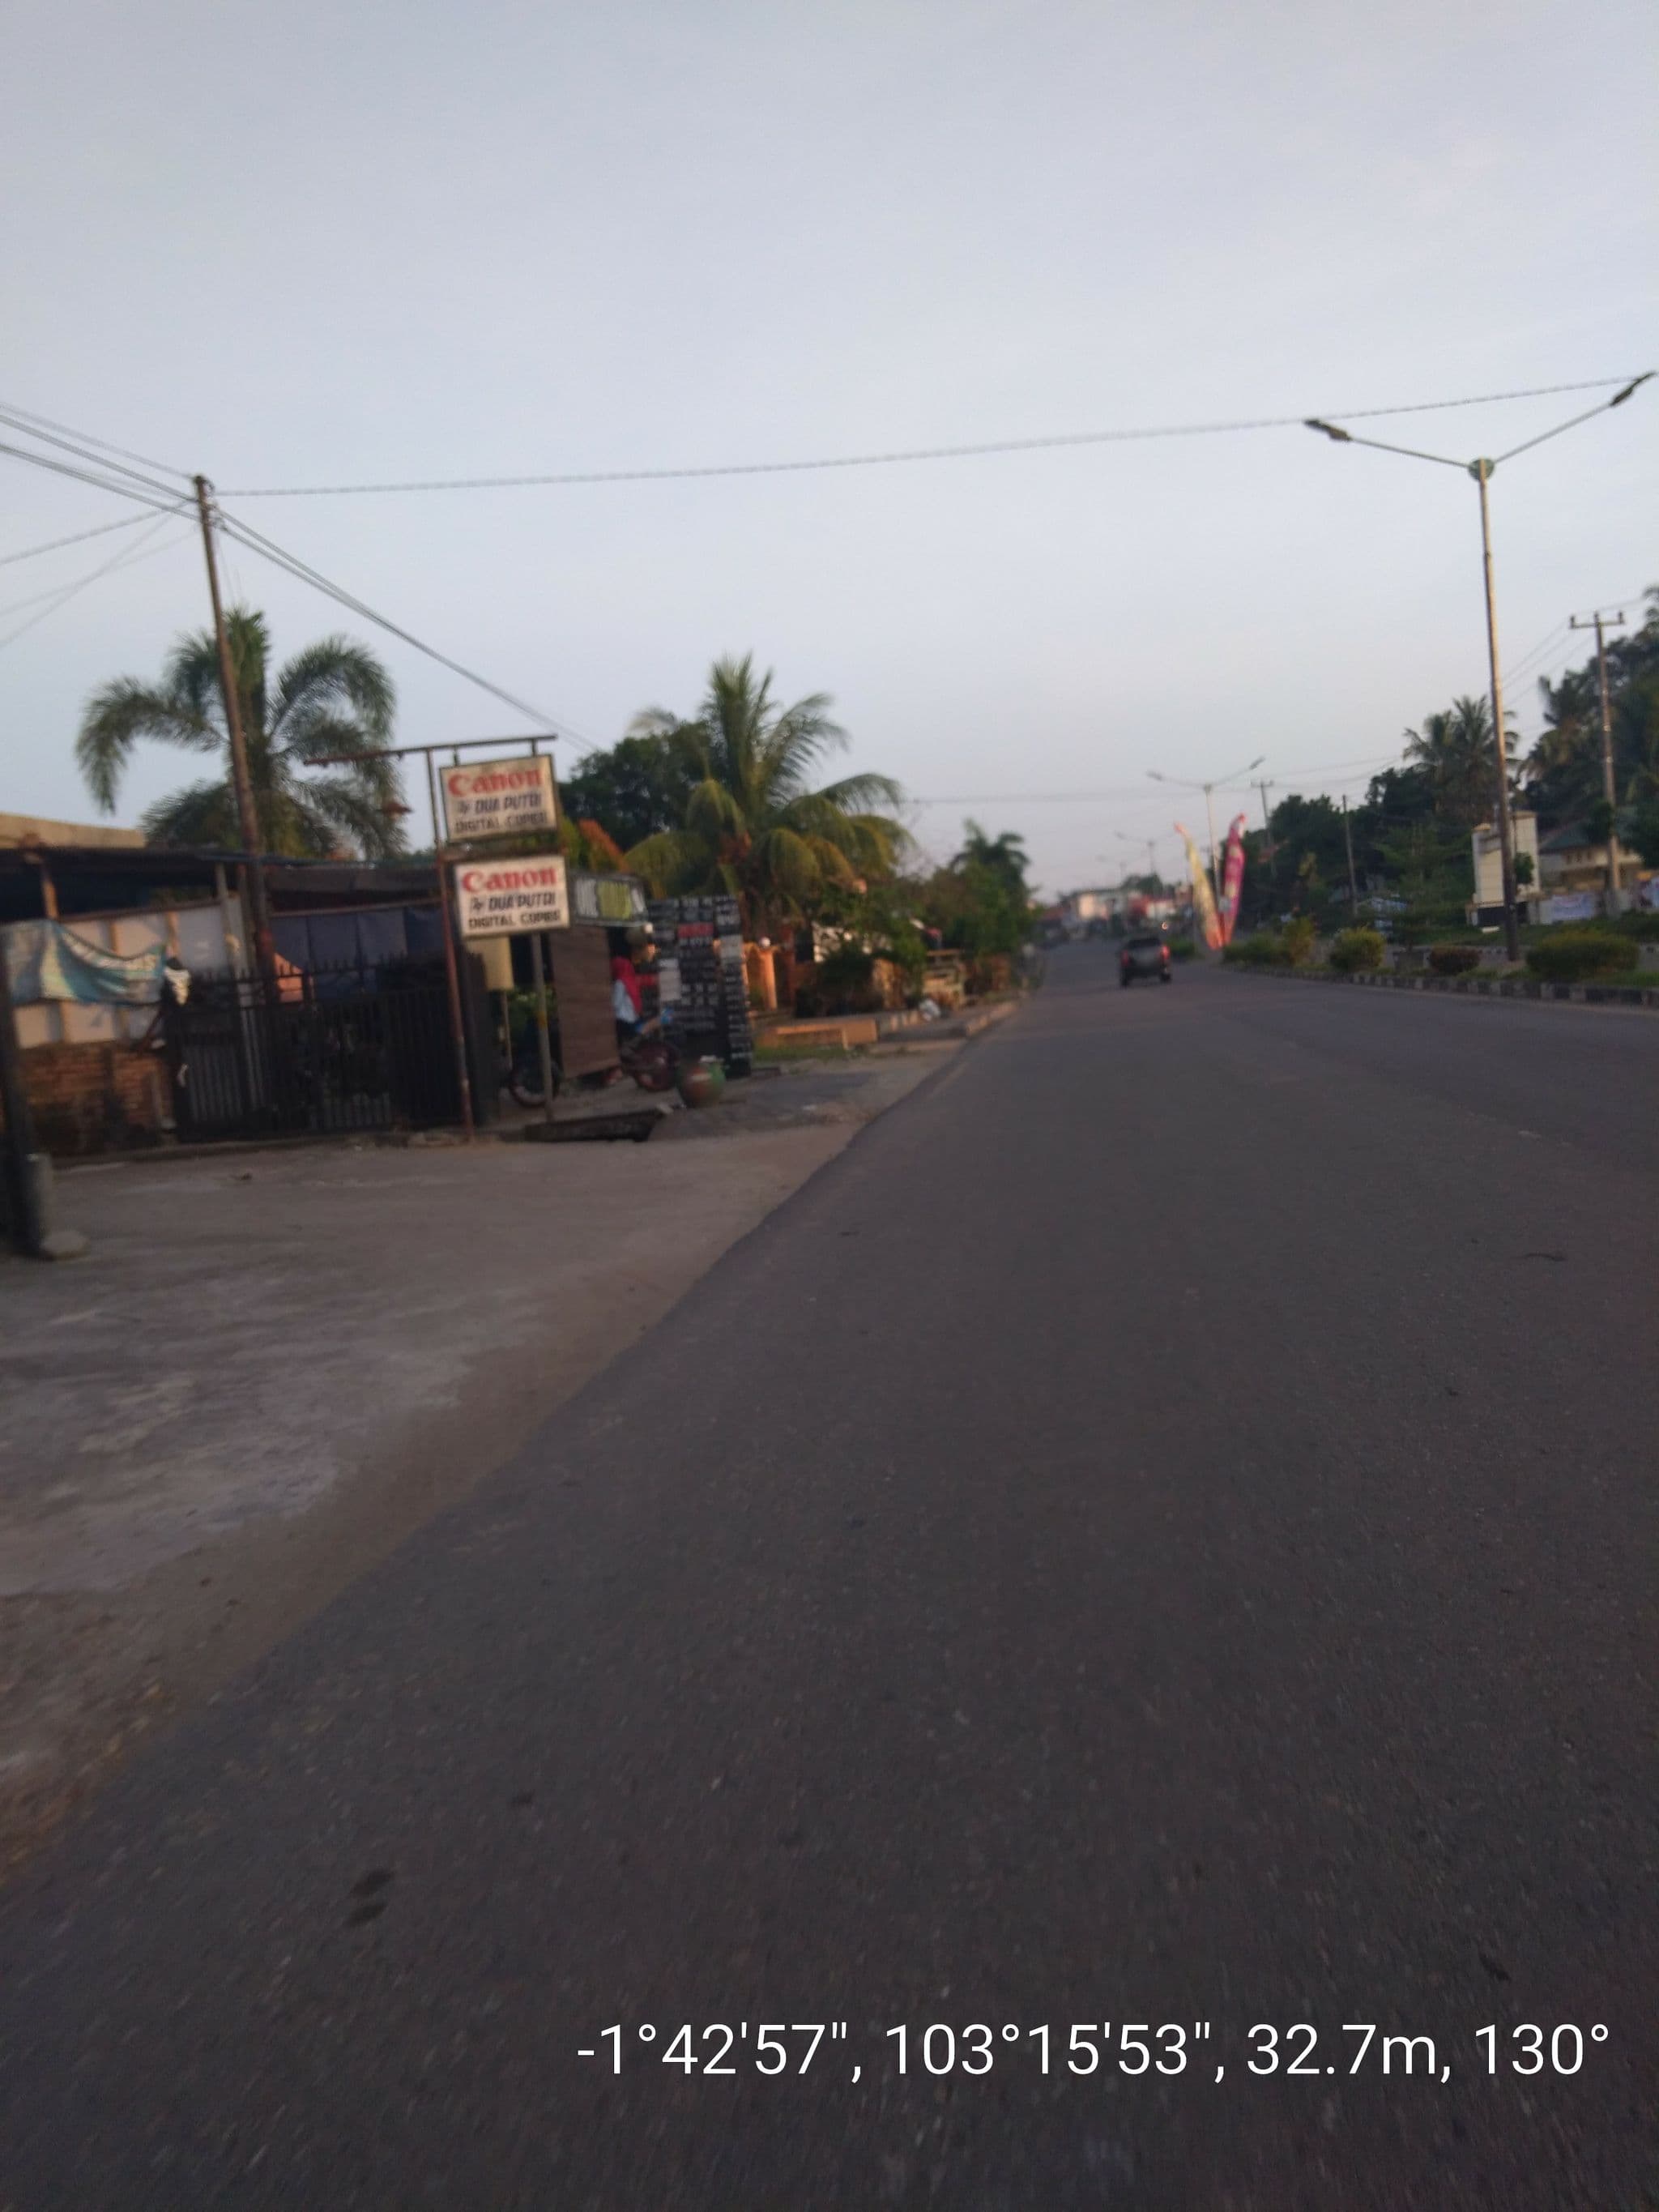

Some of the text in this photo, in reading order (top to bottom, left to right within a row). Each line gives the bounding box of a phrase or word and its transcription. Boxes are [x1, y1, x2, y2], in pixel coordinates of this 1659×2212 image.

[448, 768, 542, 796] Canon
[462, 867, 557, 893] Canon
[468, 914, 514, 928] DIGITAL
